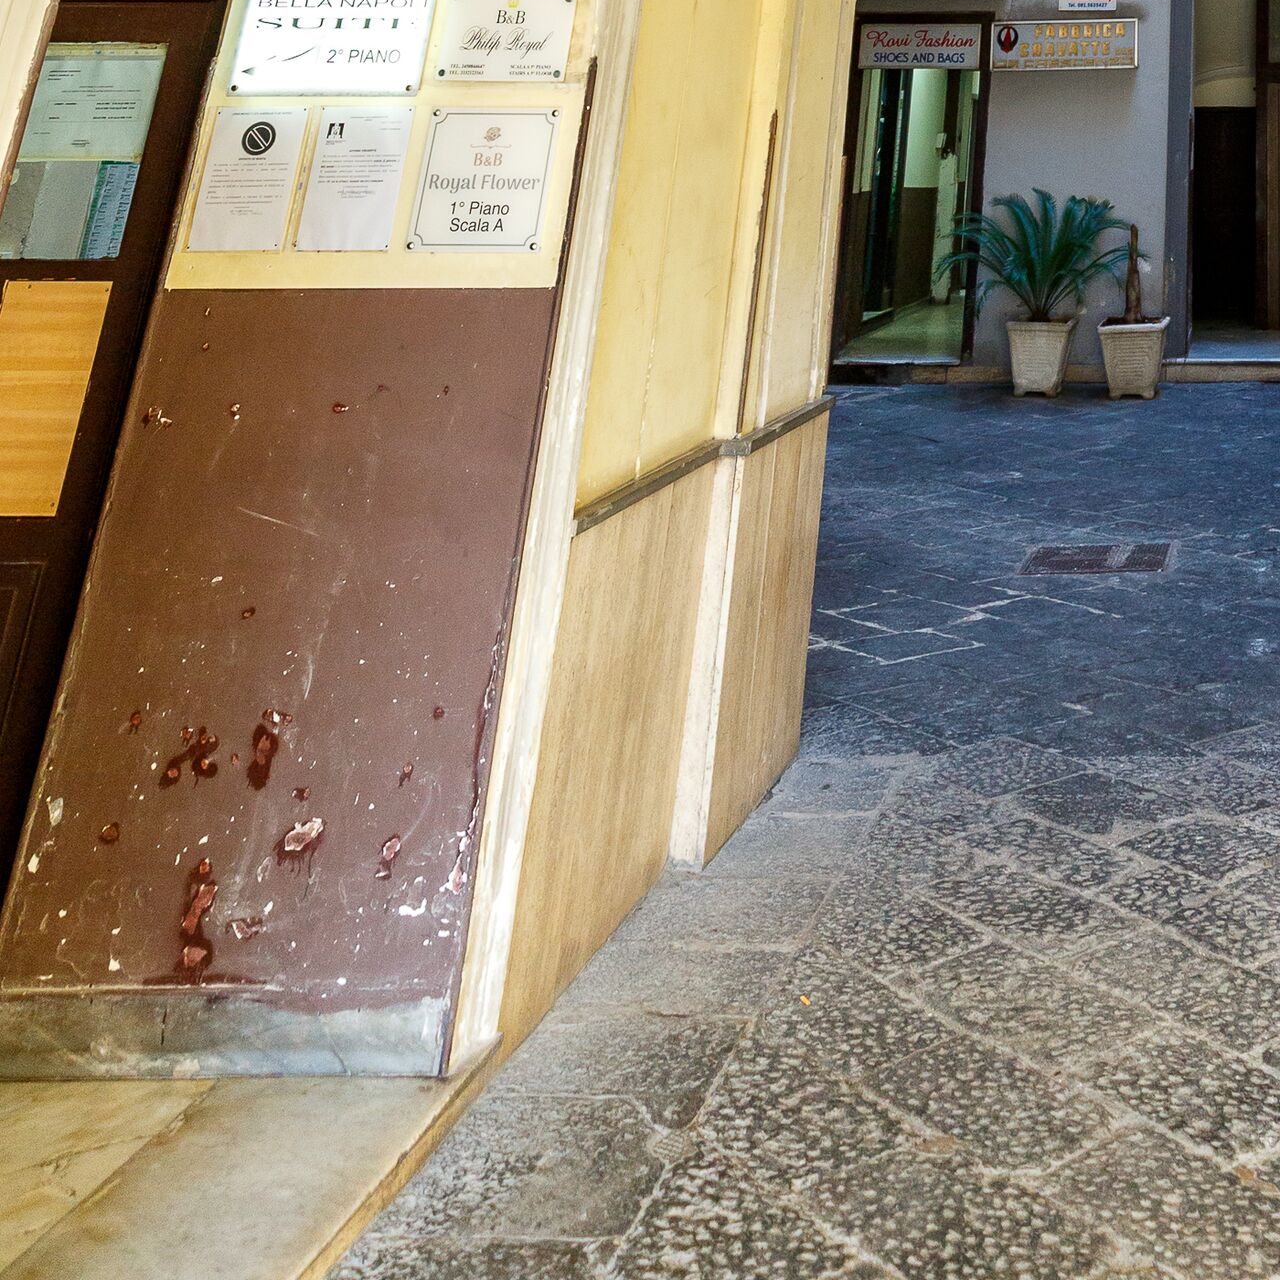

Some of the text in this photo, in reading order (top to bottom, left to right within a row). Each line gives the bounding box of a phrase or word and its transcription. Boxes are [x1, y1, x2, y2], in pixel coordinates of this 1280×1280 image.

[496, 10, 526, 24] B&B
[1034, 23, 1126, 39] FABBRICA
[460, 25, 554, 60] Philip Royal
[866, 30, 976, 48] Rovi Fashion
[347, 49, 401, 64] PIANO
[1019, 41, 1111, 57] CRAVATTE
[873, 52, 965, 63] SHOES AND BAGS
[473, 152, 503, 167] B&B
[429, 174, 540, 194] Royal Flower
[469, 201, 510, 215] Piano
[450, 218, 504, 232] Scala A
